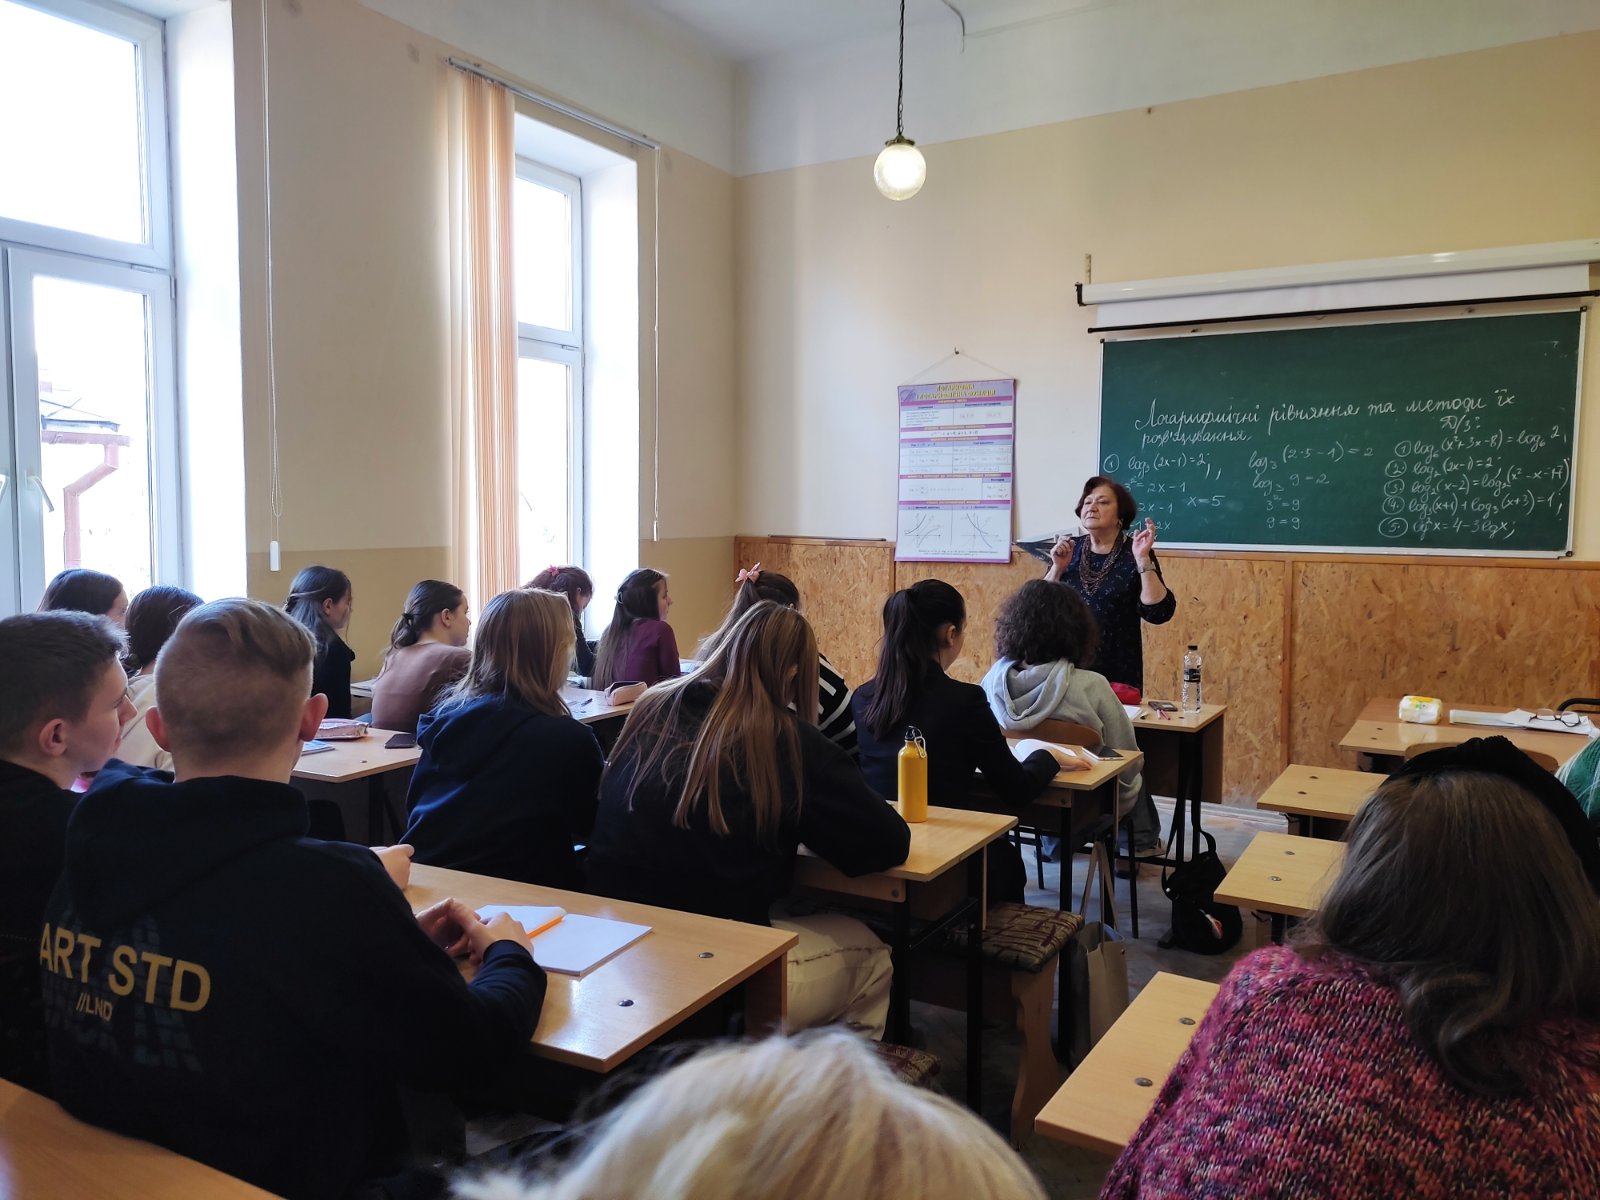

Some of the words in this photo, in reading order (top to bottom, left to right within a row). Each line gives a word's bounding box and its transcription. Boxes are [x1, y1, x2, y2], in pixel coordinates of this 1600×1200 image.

[1135, 399, 1260, 432] Логарифмічні
[1268, 403, 1360, 436] рівняння
[1368, 401, 1397, 416] та
[1406, 397, 1487, 413] методи
[39, 922, 102, 984] ART
[107, 944, 212, 1013] STD
